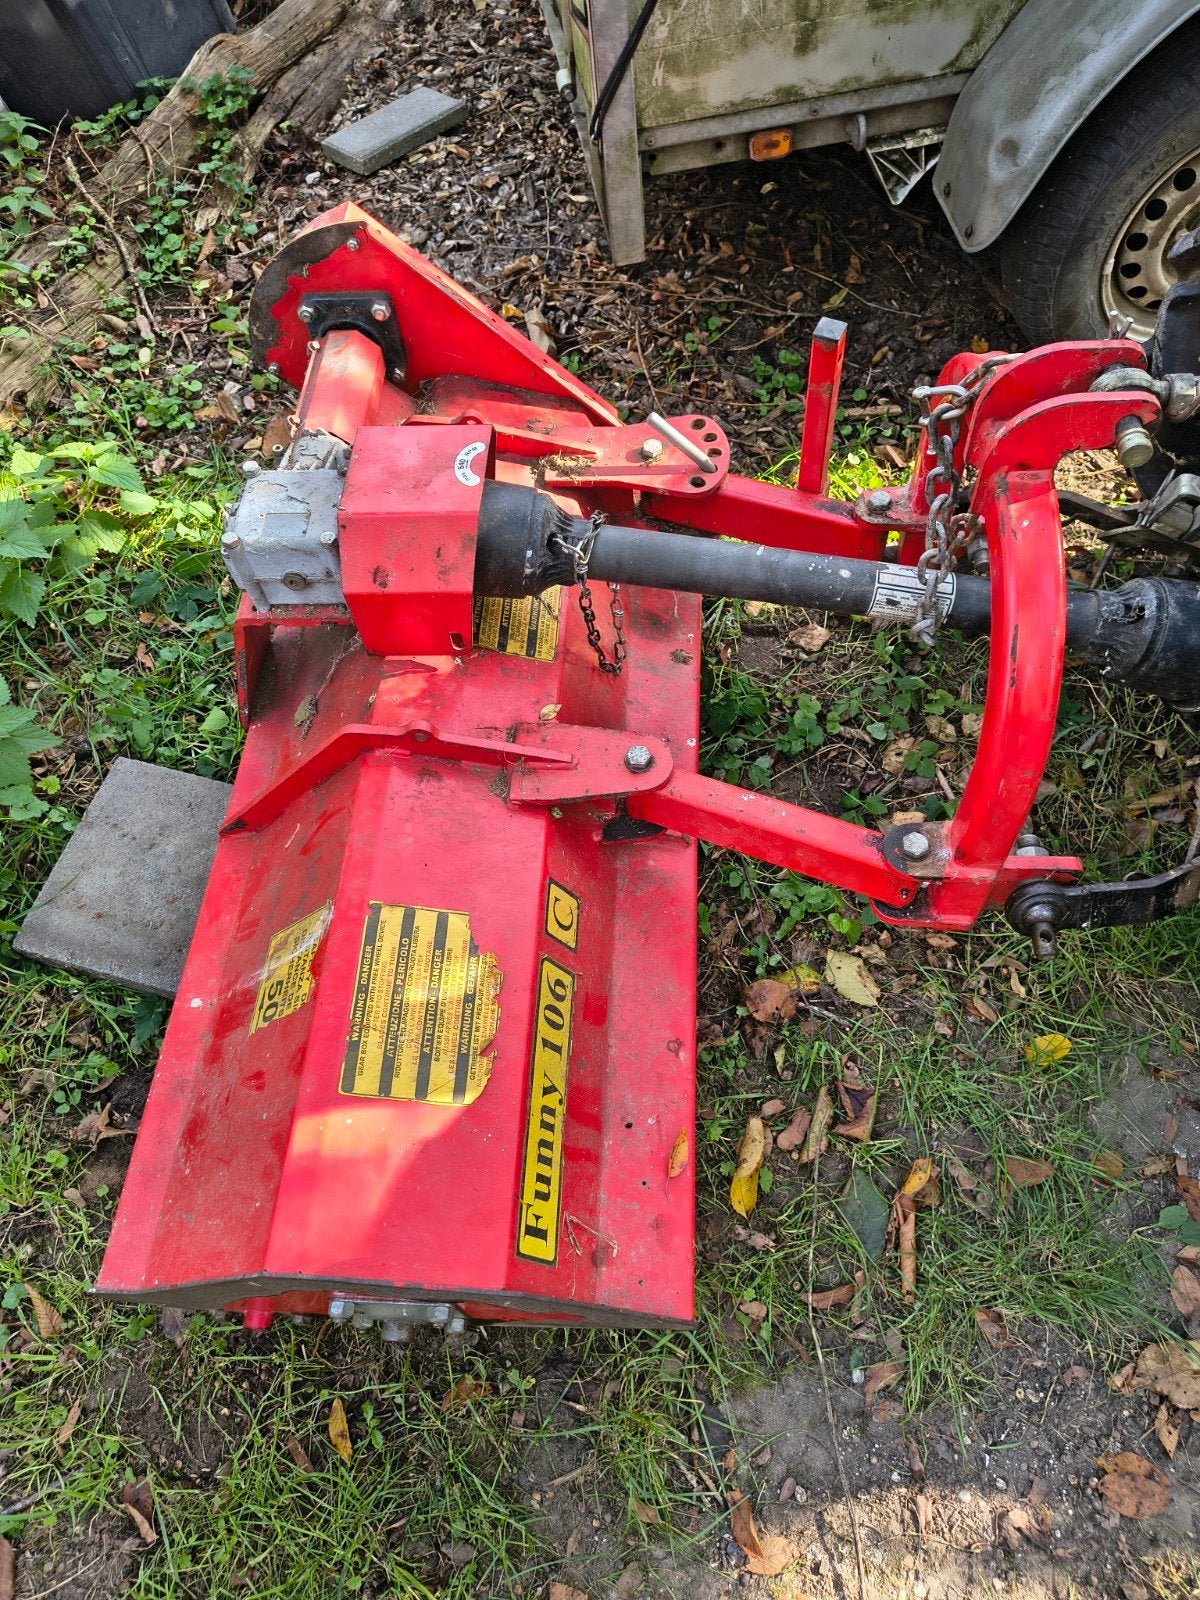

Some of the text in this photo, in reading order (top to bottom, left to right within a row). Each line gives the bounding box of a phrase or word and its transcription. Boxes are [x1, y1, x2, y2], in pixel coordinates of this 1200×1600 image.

[553, 896, 573, 931] C
[377, 919, 386, 942] DEVICE
[411, 925, 419, 948] LIBERA
[374, 943, 382, 966] WHEEL
[423, 940, 432, 972] RUOTARE
[371, 967, 379, 984] FREE
[377, 960, 387, 992] STOPPING
[381, 978, 392, 1015] CONTINUE
[387, 968, 393, 977] TO
[263, 980, 283, 1022] 50
[351, 992, 365, 1041] WARNING
[360, 945, 372, 984] DANGER
[368, 986, 376, 1002] WITH
[386, 993, 401, 1057] ATTENZIONE
[395, 937, 409, 984] PERICOLO
[422, 996, 436, 1053] ATTENTION
[430, 949, 442, 988] DANGER
[460, 1002, 472, 1053] WARNUNG
[466, 956, 477, 994] GEFAHR
[437, 1008, 445, 1032] EQUIPE
[433, 1034, 442, 1061] BOITIER
[449, 1031, 457, 1057] LAMES
[357, 1056, 365, 1075] GEAR
[524, 971, 567, 1247] Funny 106
